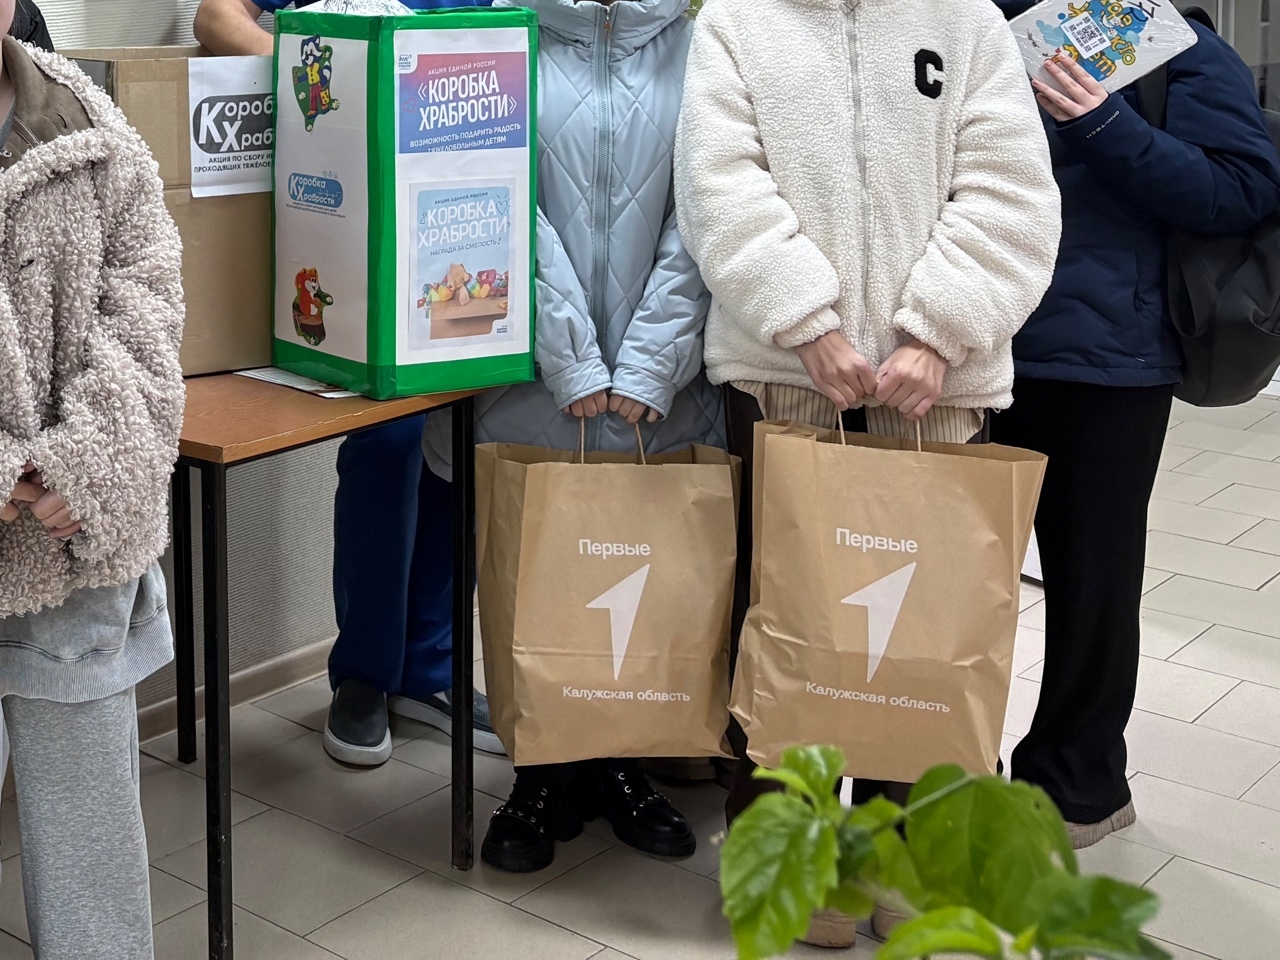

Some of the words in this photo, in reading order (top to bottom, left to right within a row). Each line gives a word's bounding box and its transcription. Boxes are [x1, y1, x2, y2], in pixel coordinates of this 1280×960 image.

[1110, 34, 1136, 66] кто
[428, 66, 447, 75] АКЦИЯ
[449, 63, 472, 72] ЕДИНОЙ
[473, 60, 496, 69] РОССИИ
[914, 48, 944, 99] C
[417, 70, 500, 104] «КОРОБКА
[418, 93, 517, 132] ХРАБРОСТИ»
[410, 134, 459, 148] ВОЗМОЖНОСТЬ
[460, 128, 493, 141] ПОДАРИТЬ
[493, 123, 522, 135] РАДОСТЬ
[485, 135, 507, 146] ДЕТЯМ
[194, 163, 241, 173] ПРОХОДЯЩИХ
[243, 153, 265, 161] СБОРУ
[430, 246, 456, 256] НАГРАДА
[579, 539, 651, 560] Первые
[836, 527, 919, 554] Первые
[563, 687, 634, 700] Калужская
[637, 690, 691, 702] область
[806, 681, 886, 705] Калужская
[890, 696, 951, 713] область
